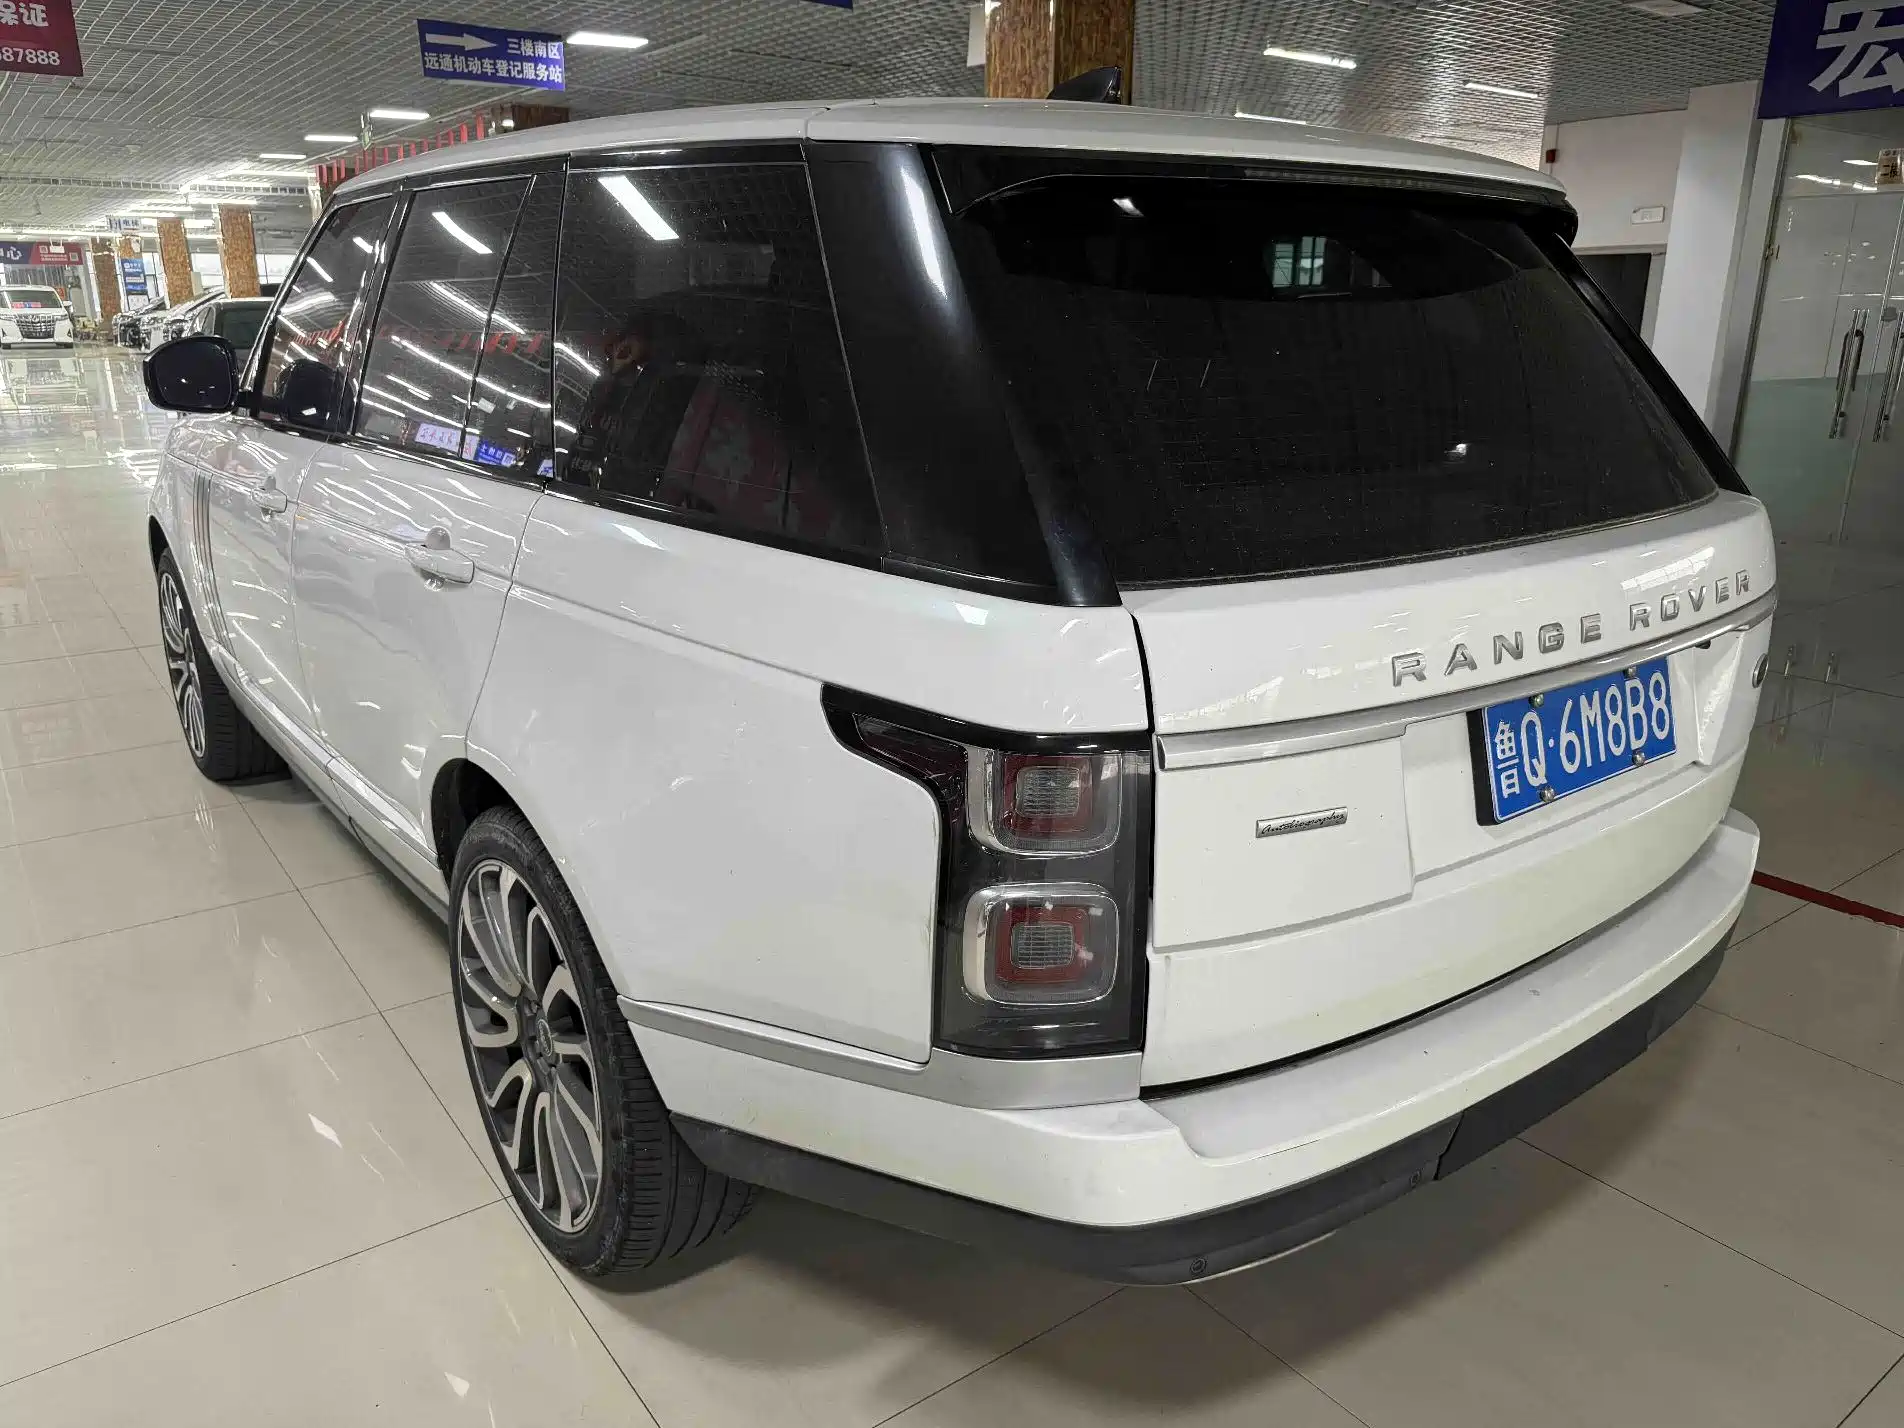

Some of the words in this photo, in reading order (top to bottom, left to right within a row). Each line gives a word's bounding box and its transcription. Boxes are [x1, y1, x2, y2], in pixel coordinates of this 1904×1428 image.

[507, 37, 562, 59] 三楼南区
[424, 52, 563, 83] 远通机动车登记服务站
[1391, 613, 1604, 687] RANGE
[1629, 568, 1751, 632] ROVER
